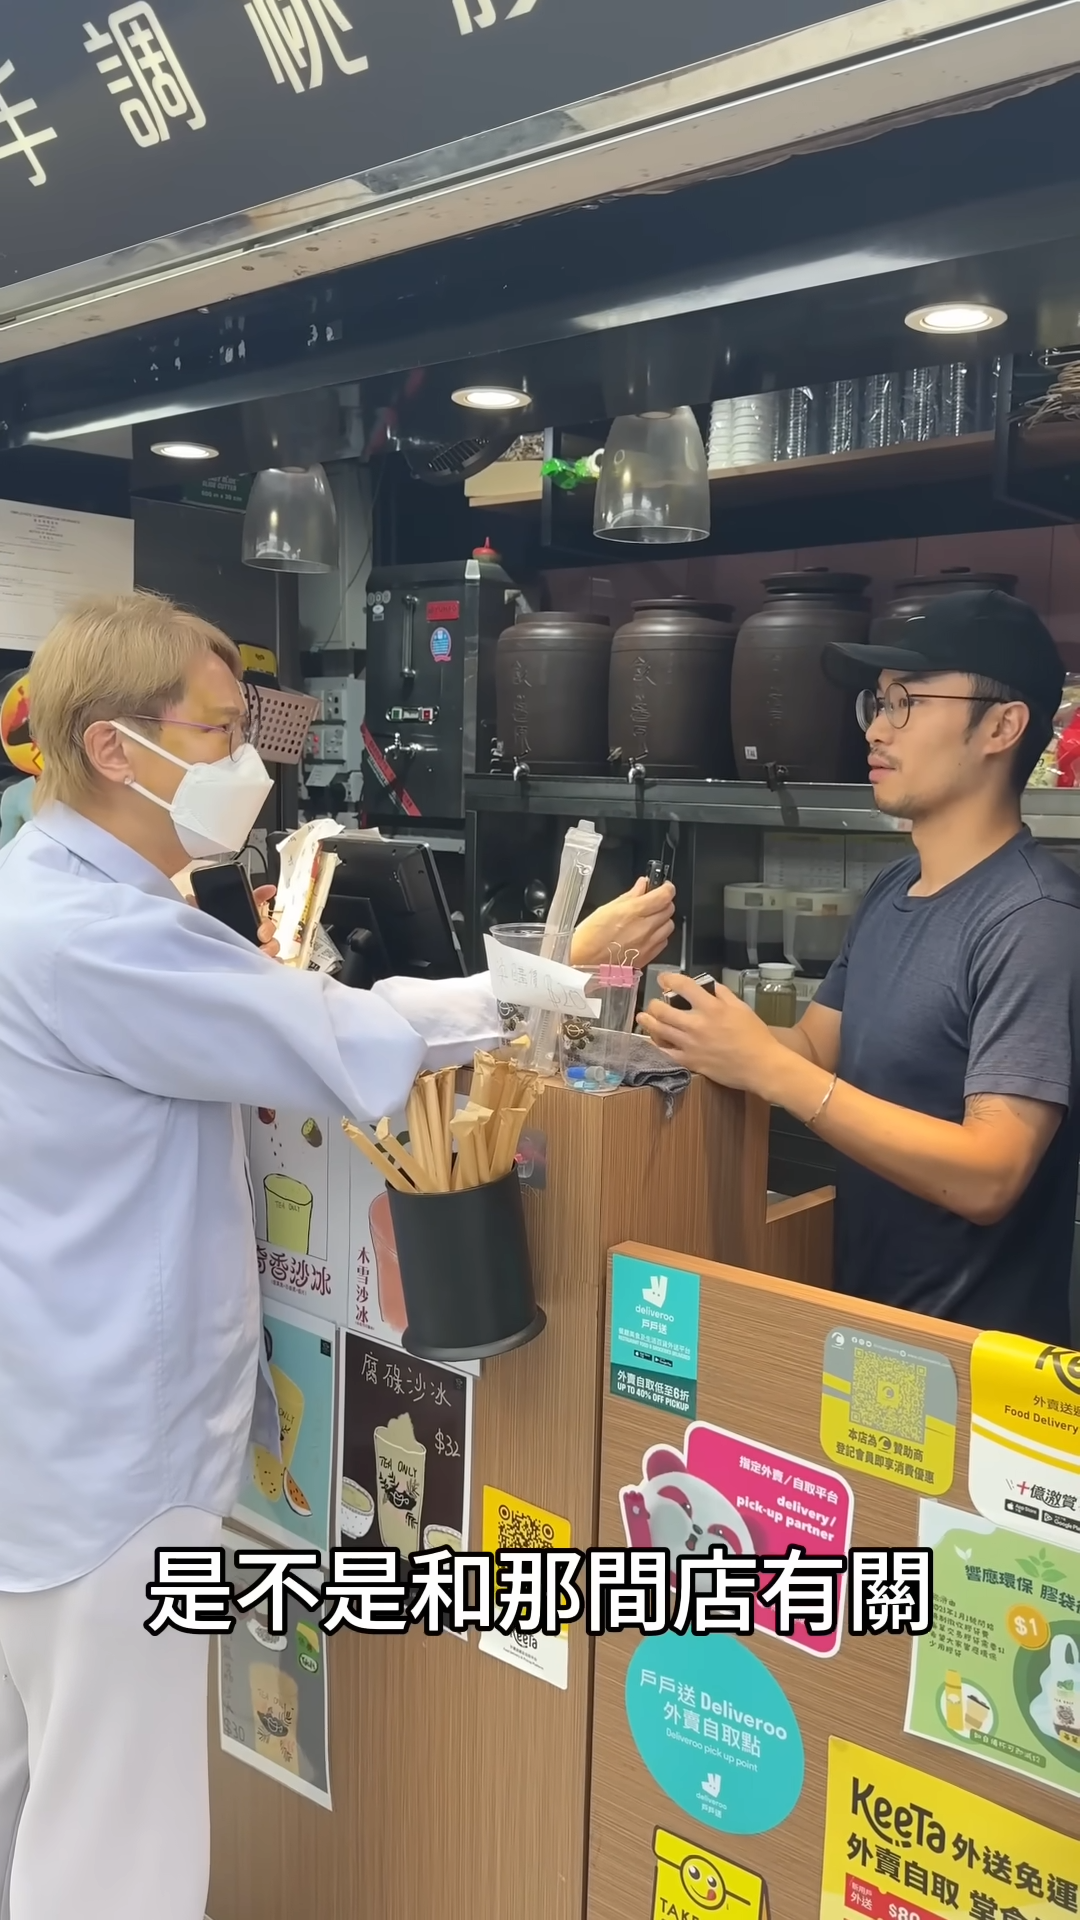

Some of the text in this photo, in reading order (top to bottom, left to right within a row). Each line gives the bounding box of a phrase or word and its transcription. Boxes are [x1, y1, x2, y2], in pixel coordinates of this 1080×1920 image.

[635, 1304, 674, 1322] deliveroo
[617, 1370, 690, 1403] 外賣自取低至6折
[617, 1382, 690, 1412] UP TO 40% OFF PICKUP
[1005, 1405, 1079, 1435] Food Delivery
[435, 1428, 461, 1457] $32
[848, 1428, 877, 1447] 本店為
[379, 1456, 417, 1478] TEA ONLY
[736, 1495, 835, 1542] pick-up partner
[965, 1565, 1033, 1595] 響應環保
[1014, 1615, 1038, 1637] $1
[640, 1668, 787, 1740] 戶戶送 Deliveroo
[663, 1701, 761, 1758] 外賣自取點
[666, 1727, 758, 1773] Deliveroo pick up point
[696, 1792, 728, 1810] deliveroo
[851, 1776, 1079, 1914] KeeTa 外送免運
[847, 1832, 959, 1909] 外賣自取
[850, 1891, 873, 1911] 外送
